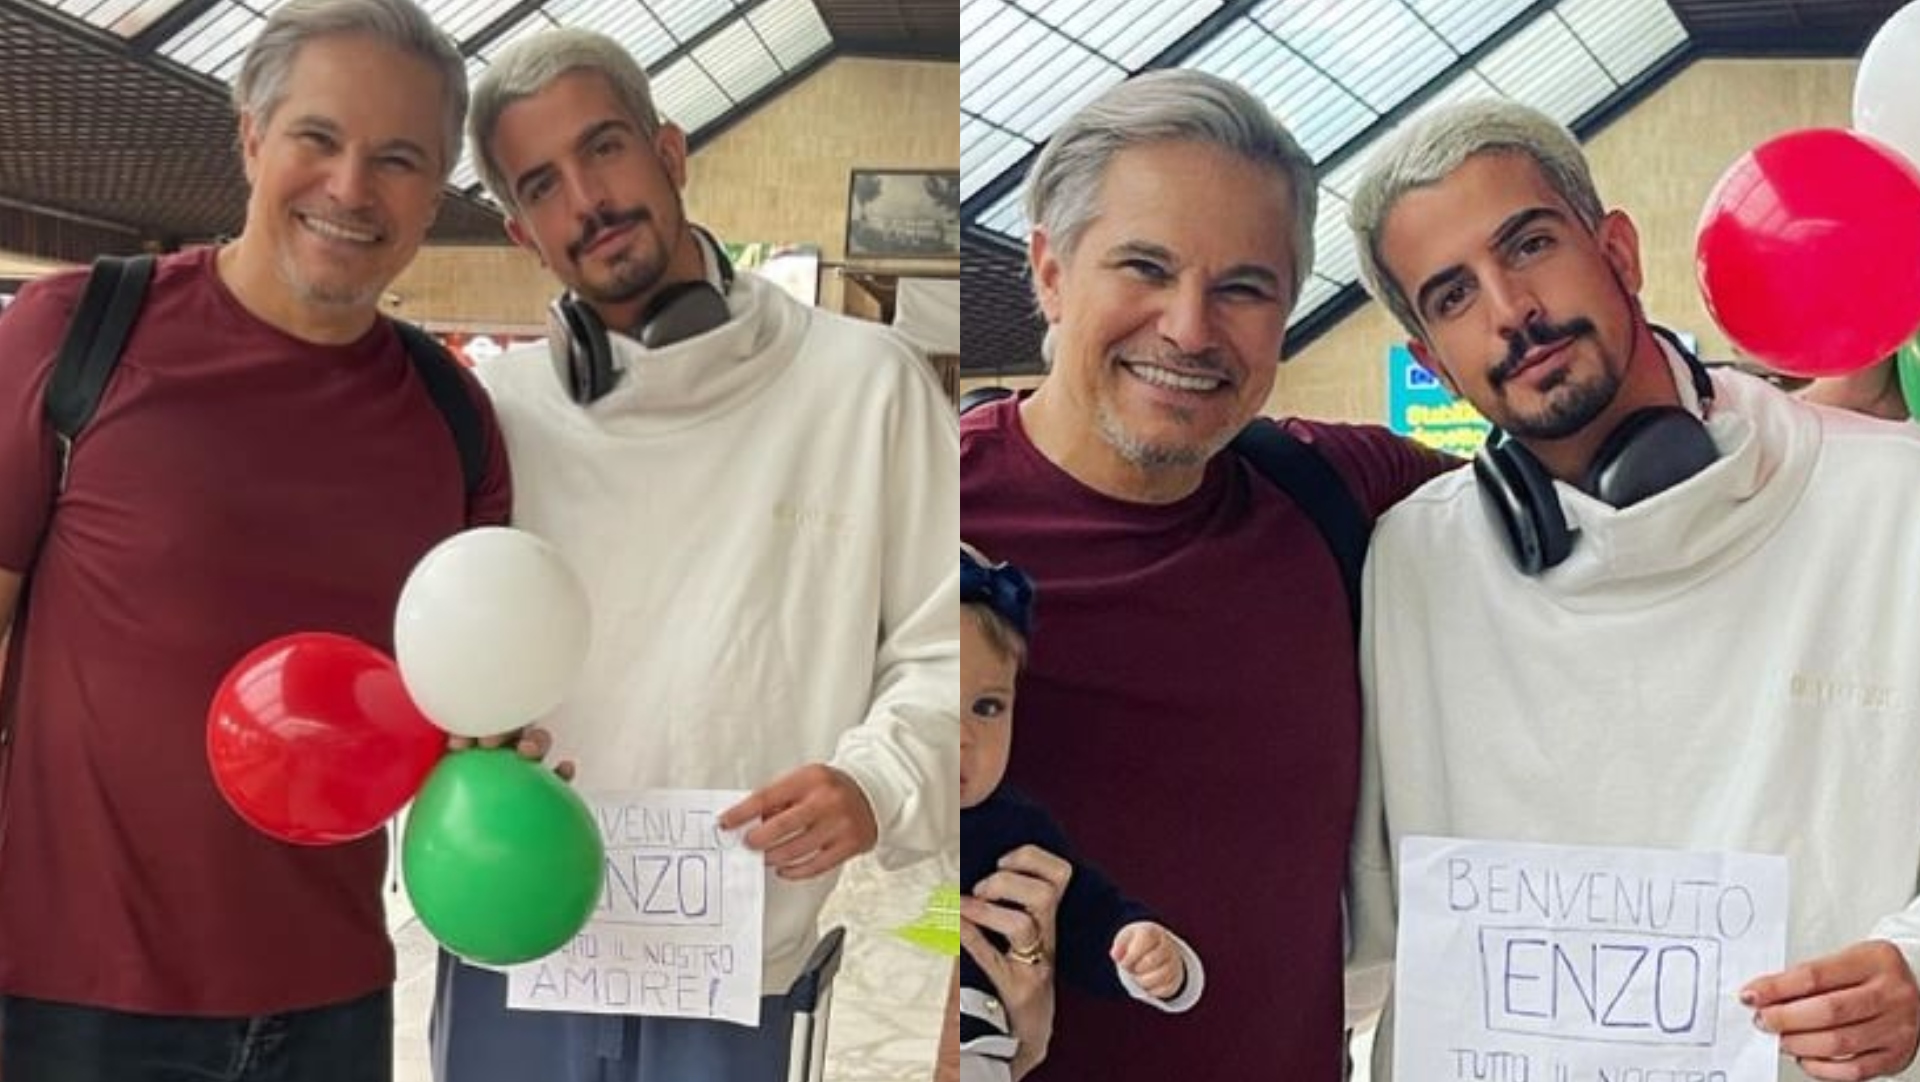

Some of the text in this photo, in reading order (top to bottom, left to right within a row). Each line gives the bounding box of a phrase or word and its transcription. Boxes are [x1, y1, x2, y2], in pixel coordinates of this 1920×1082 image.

[605, 855, 708, 917] NZO
[1447, 858, 1755, 939] BENVENUTO
[645, 942, 734, 975] NOSTRO
[1504, 939, 1701, 1033] ENZO
[529, 963, 722, 1017] AMORE!
